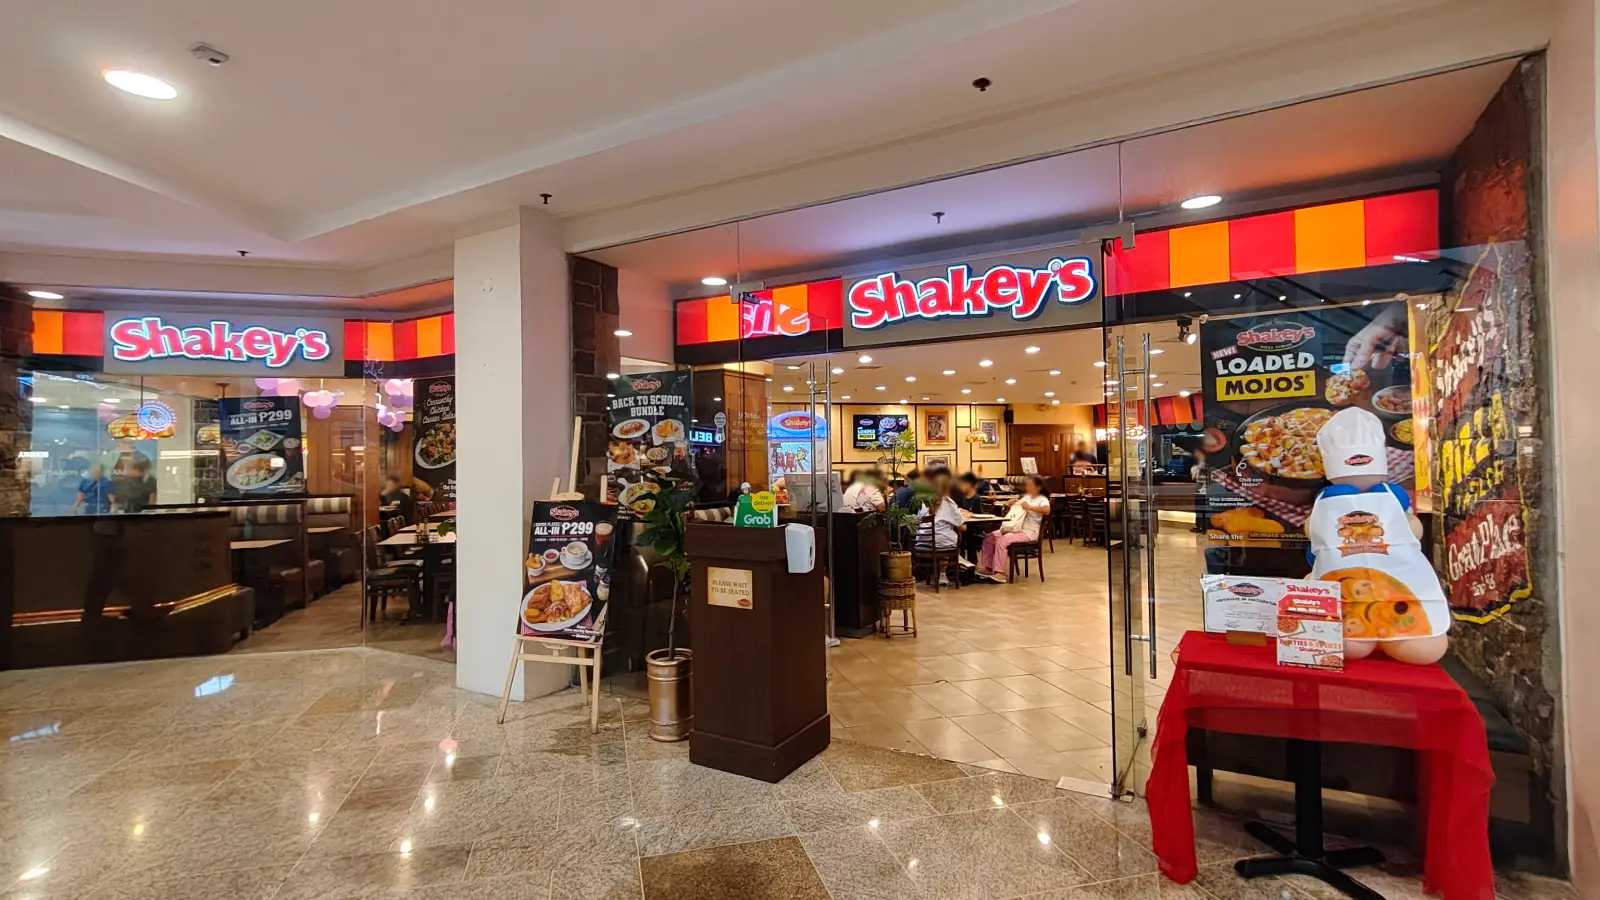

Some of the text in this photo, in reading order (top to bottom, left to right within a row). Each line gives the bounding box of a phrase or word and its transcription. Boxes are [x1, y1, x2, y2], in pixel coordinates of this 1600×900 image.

[849, 257, 1094, 330] Shakey's
[109, 317, 330, 368] Shakey's
[1236, 327, 1315, 346] Shakey's
[1212, 346, 1237, 359] NEW!
[1215, 352, 1315, 375] LOADED
[612, 394, 685, 410] BACK TO SCHOOL
[630, 405, 665, 418] BUNDLE
[230, 415, 257, 426] ALL-IN
[743, 513, 772, 525] Grab
[534, 526, 560, 535] ALL-IN
[1209, 532, 1230, 540] Share
[1286, 584, 1330, 595] Shakey's
